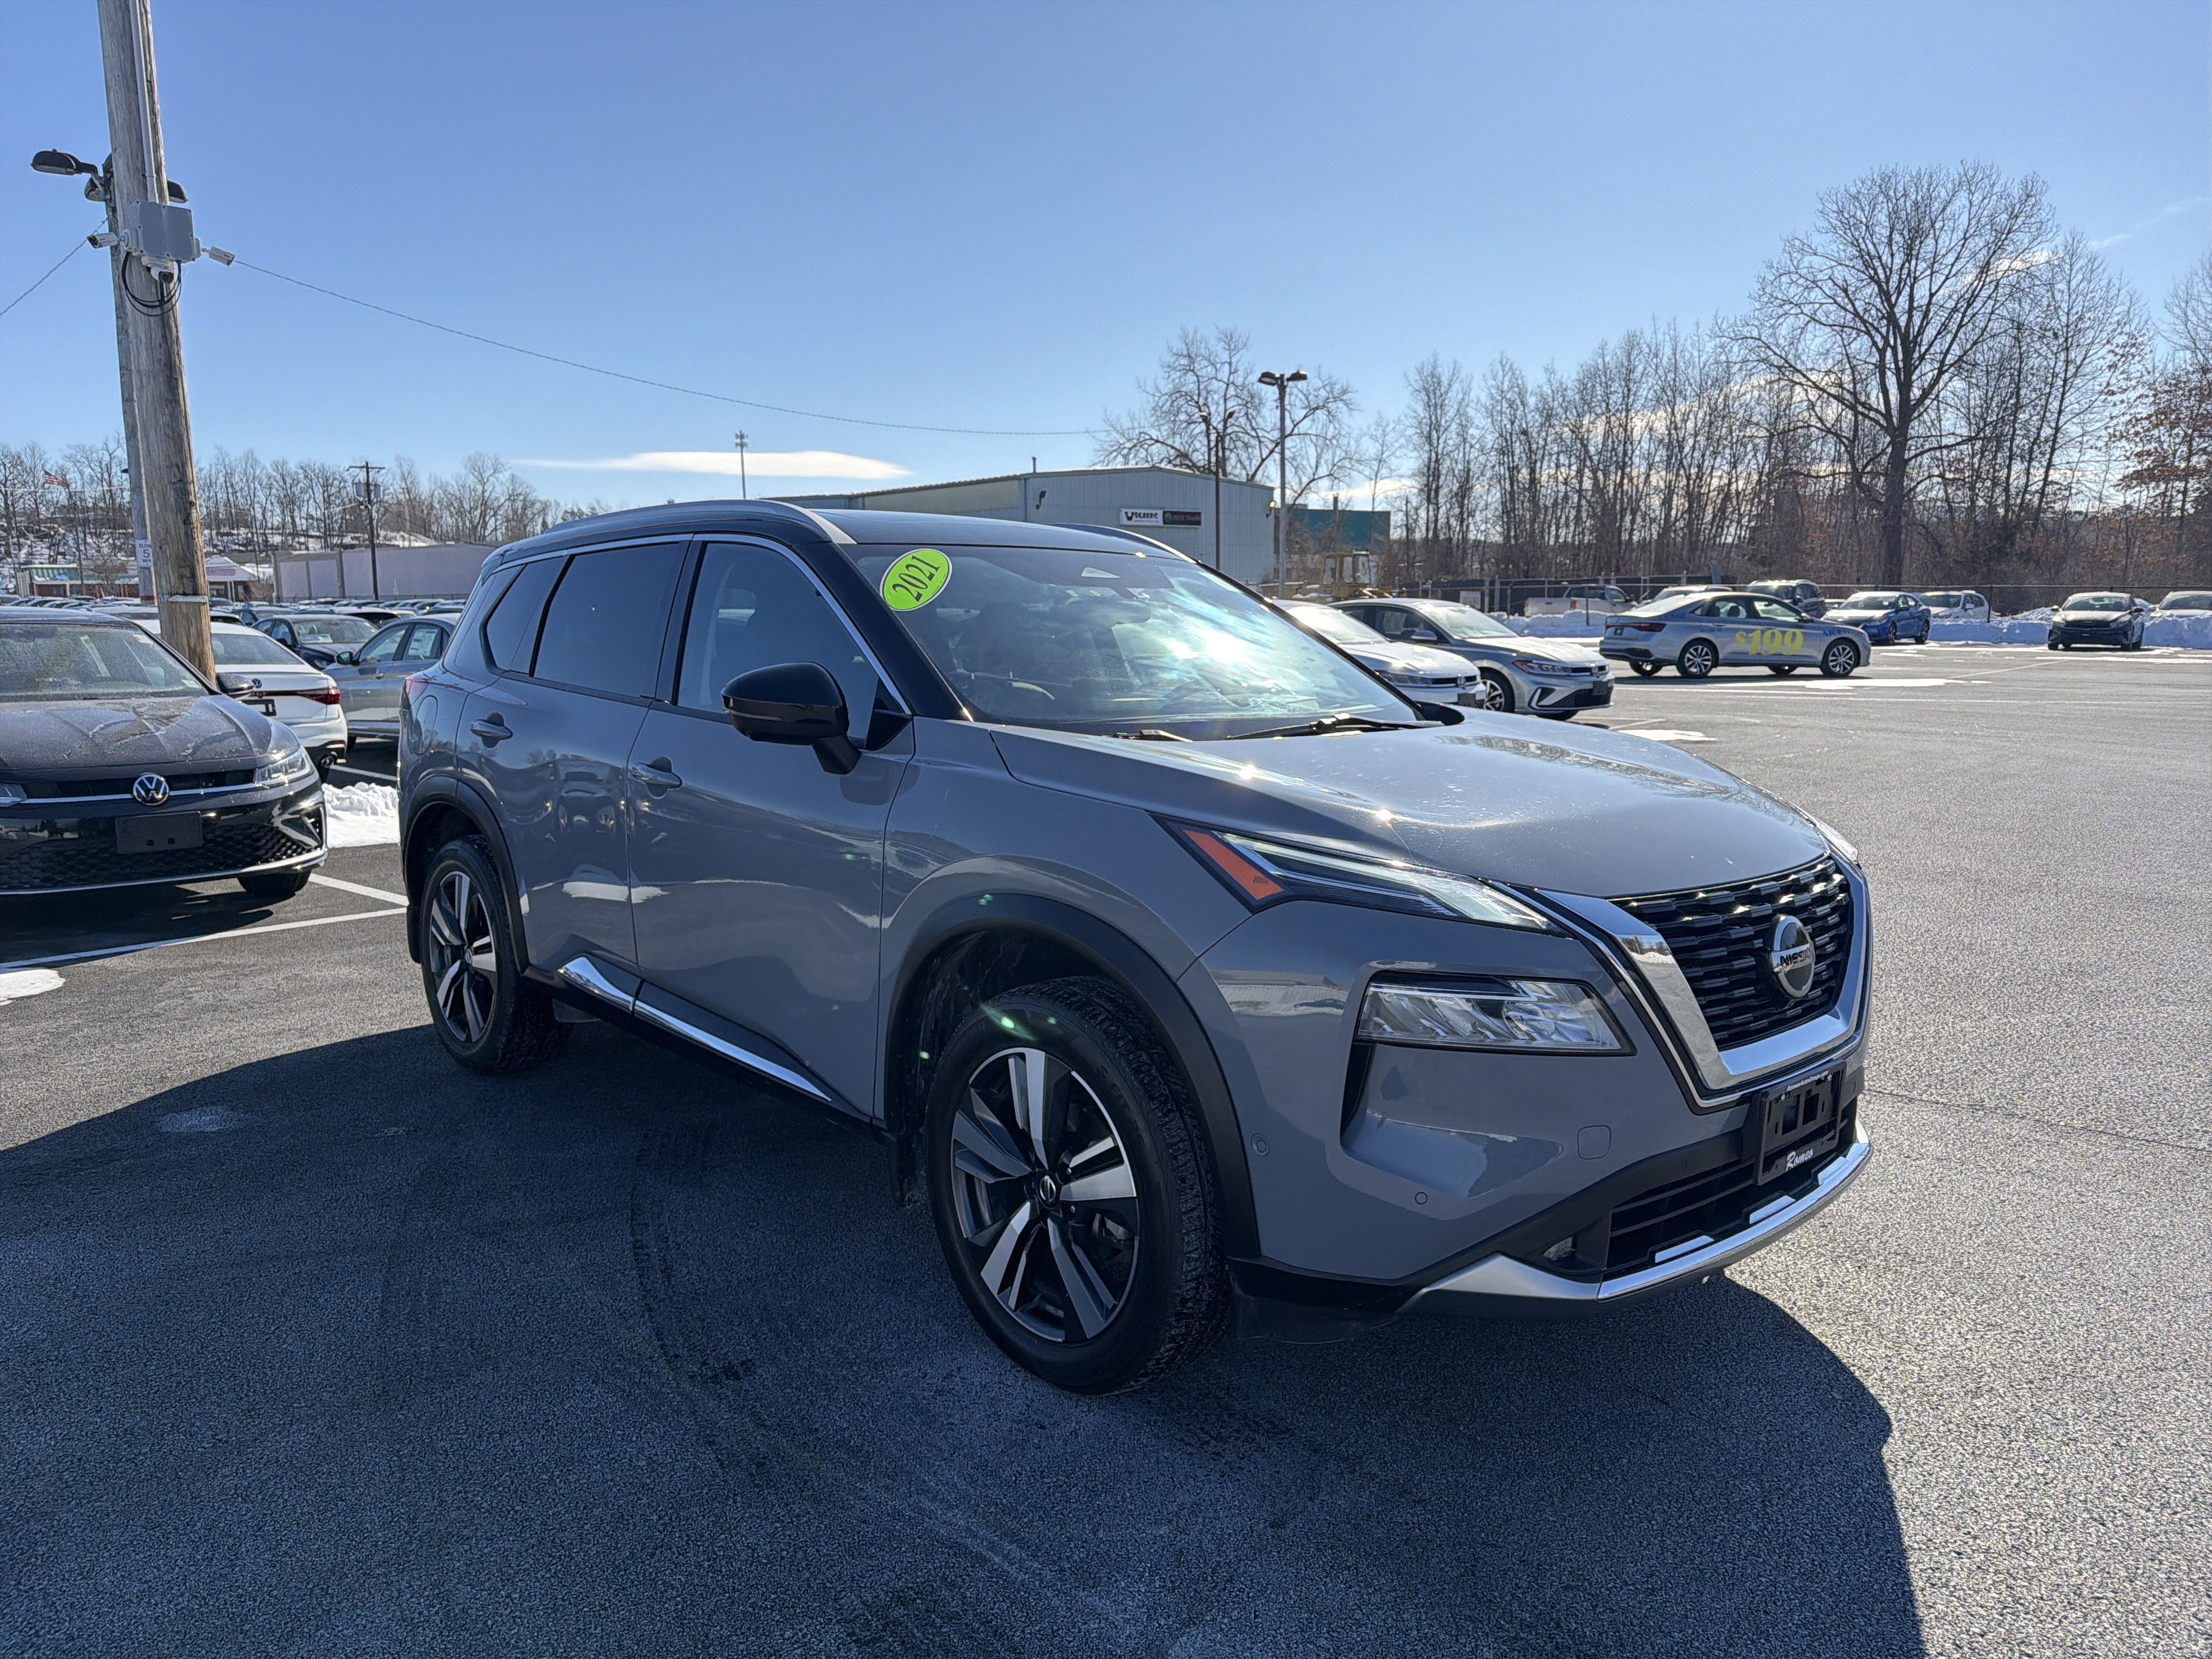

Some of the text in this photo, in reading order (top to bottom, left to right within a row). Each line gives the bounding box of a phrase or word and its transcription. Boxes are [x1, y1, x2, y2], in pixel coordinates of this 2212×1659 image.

[143, 549, 150, 558] 5
[891, 555, 941, 602] 2021
[1735, 628, 1804, 656] $199
